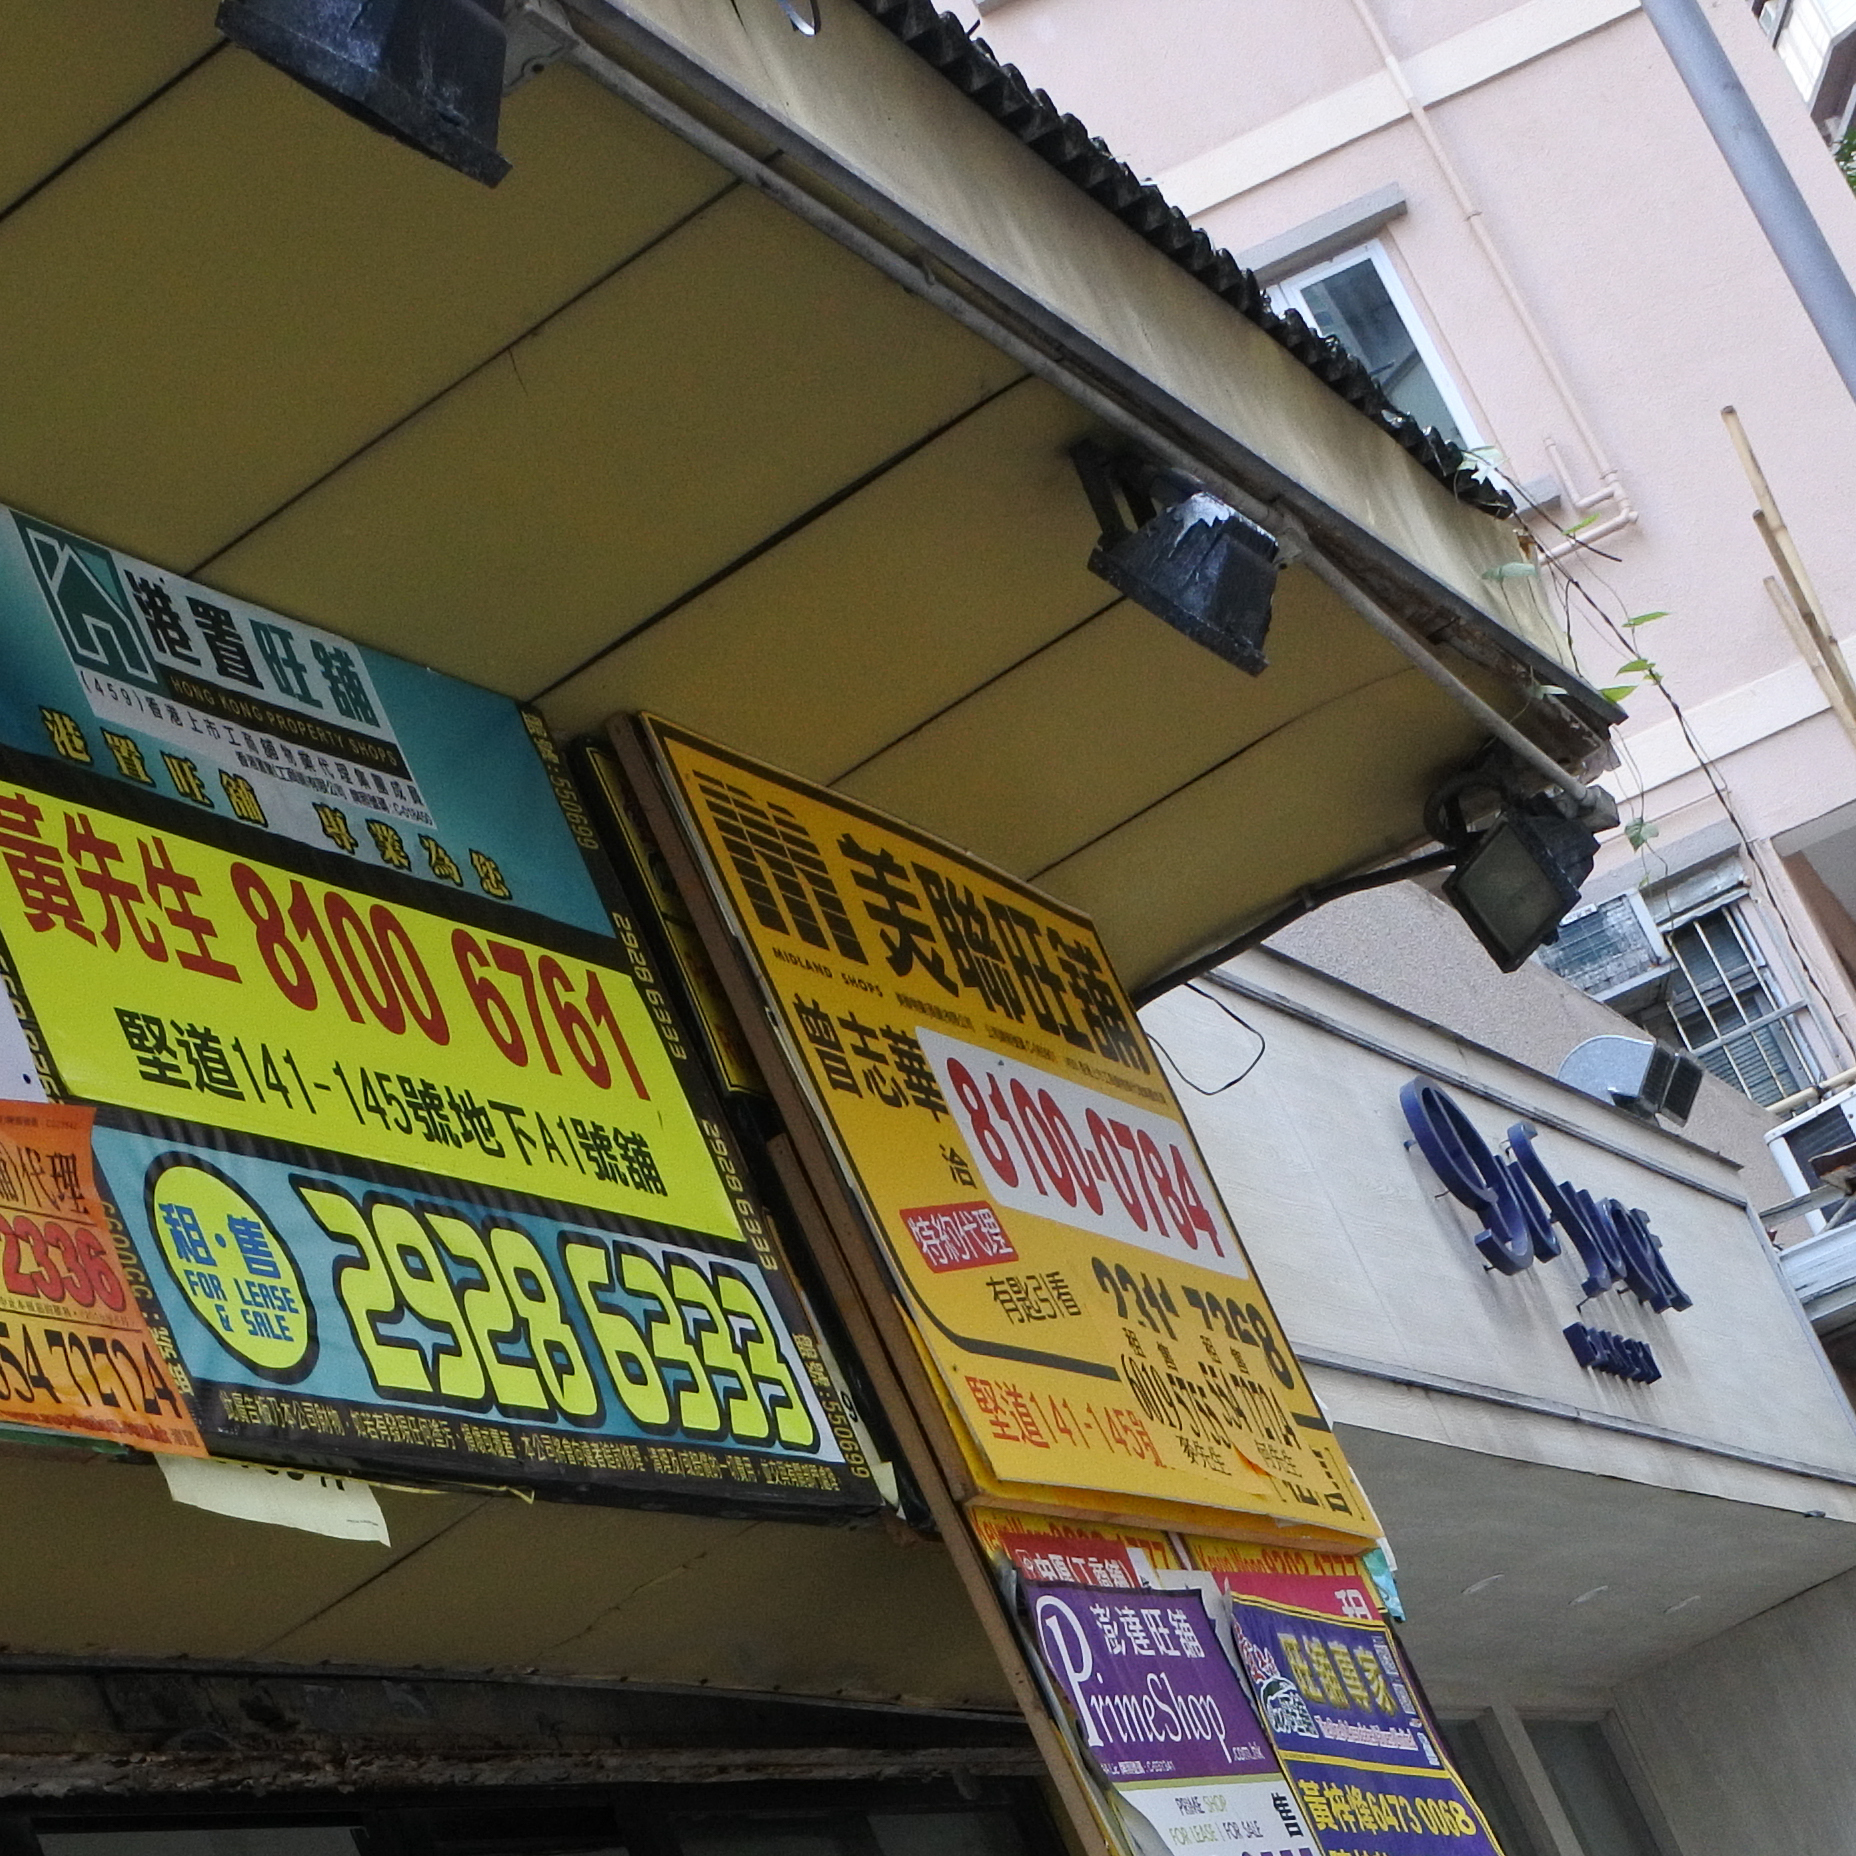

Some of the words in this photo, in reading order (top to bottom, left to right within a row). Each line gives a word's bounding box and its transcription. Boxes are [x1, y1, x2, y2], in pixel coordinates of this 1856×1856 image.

[124, 569, 382, 730] 港置旺舖
[170, 673, 218, 711] HONG
[220, 689, 265, 726] KONG
[266, 704, 347, 750] PROPERTY
[349, 733, 399, 768] SHOPS
[41, 706, 269, 828] 港置旺舖
[314, 803, 513, 902] 專業為您
[228, 860, 449, 1046] 8100
[449, 926, 652, 1102] 6761
[772, 947, 835, 981] MIDLAND
[841, 971, 885, 998] SHOPS
[793, 992, 950, 1124] 曾志華
[947, 1057, 1226, 1260] 8100-0784
[185, 1268, 227, 1304] FOR
[237, 1276, 296, 1316] LEASE
[907, 1211, 1014, 1266] 特約代理
[215, 1302, 233, 1333] &
[239, 1307, 295, 1343] SALE
[290, 1180, 602, 1420] 2928
[561, 1234, 822, 1450] 6333
[1418, 1796, 1478, 1837] 0068
